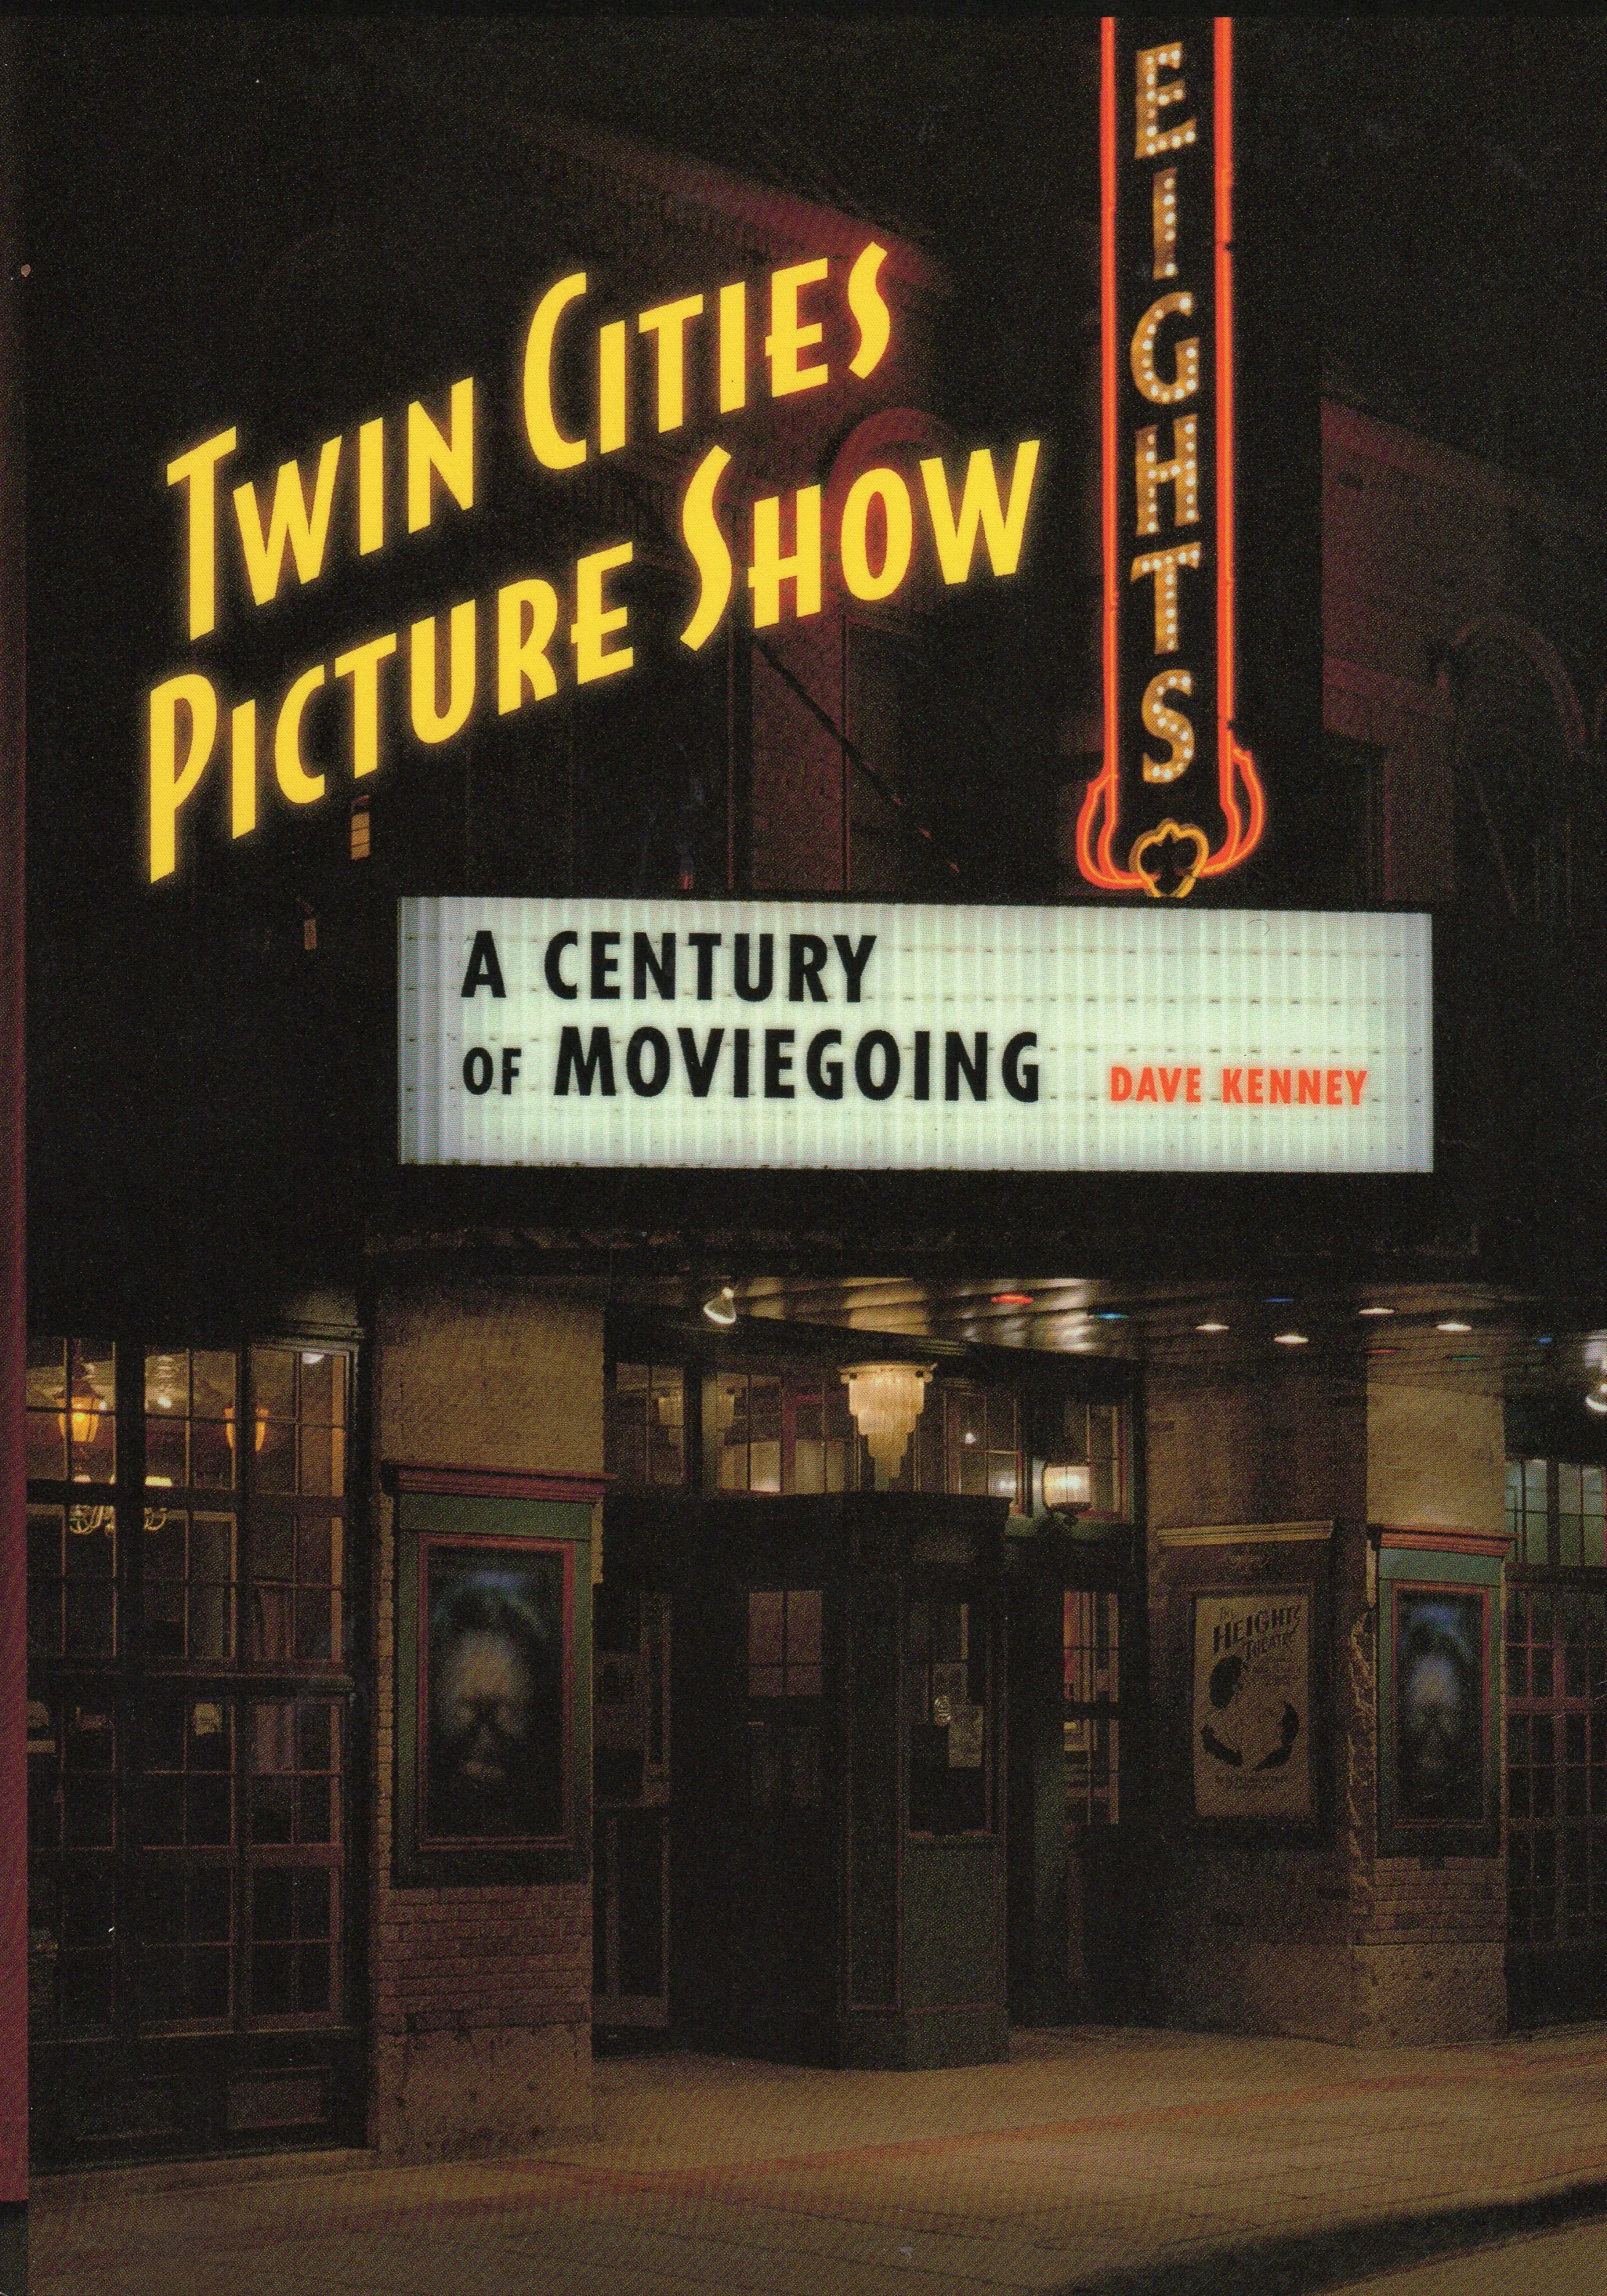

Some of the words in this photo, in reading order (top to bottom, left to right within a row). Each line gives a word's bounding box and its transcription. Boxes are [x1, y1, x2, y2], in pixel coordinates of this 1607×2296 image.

[1131, 42, 1201, 783] EIGHTS
[460, 930, 506, 1000] A
[543, 930, 877, 1003] CENTURY
[461, 1046, 523, 1097] OF
[553, 1025, 1040, 1104] MOVIEGOING
[1110, 1065, 1202, 1105] DAVE
[1222, 1067, 1368, 1106] KENNEY
[1214, 1604, 1301, 1654] HEIGHTS
